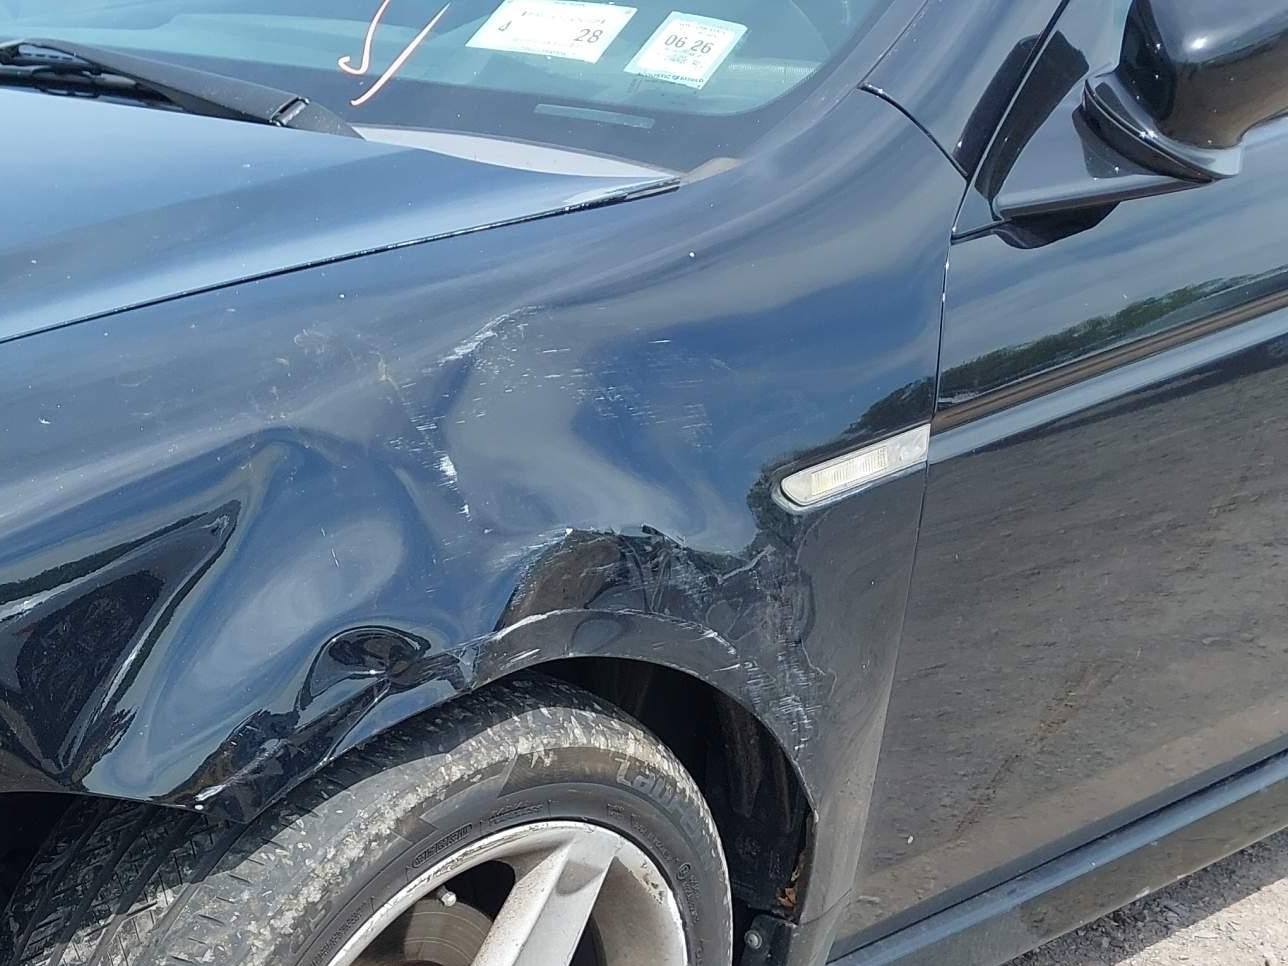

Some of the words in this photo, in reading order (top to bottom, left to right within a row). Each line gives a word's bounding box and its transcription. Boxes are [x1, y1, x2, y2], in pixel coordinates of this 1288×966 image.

[573, 28, 604, 44] 28
[664, 33, 688, 49] 06
[690, 39, 715, 54] 26
